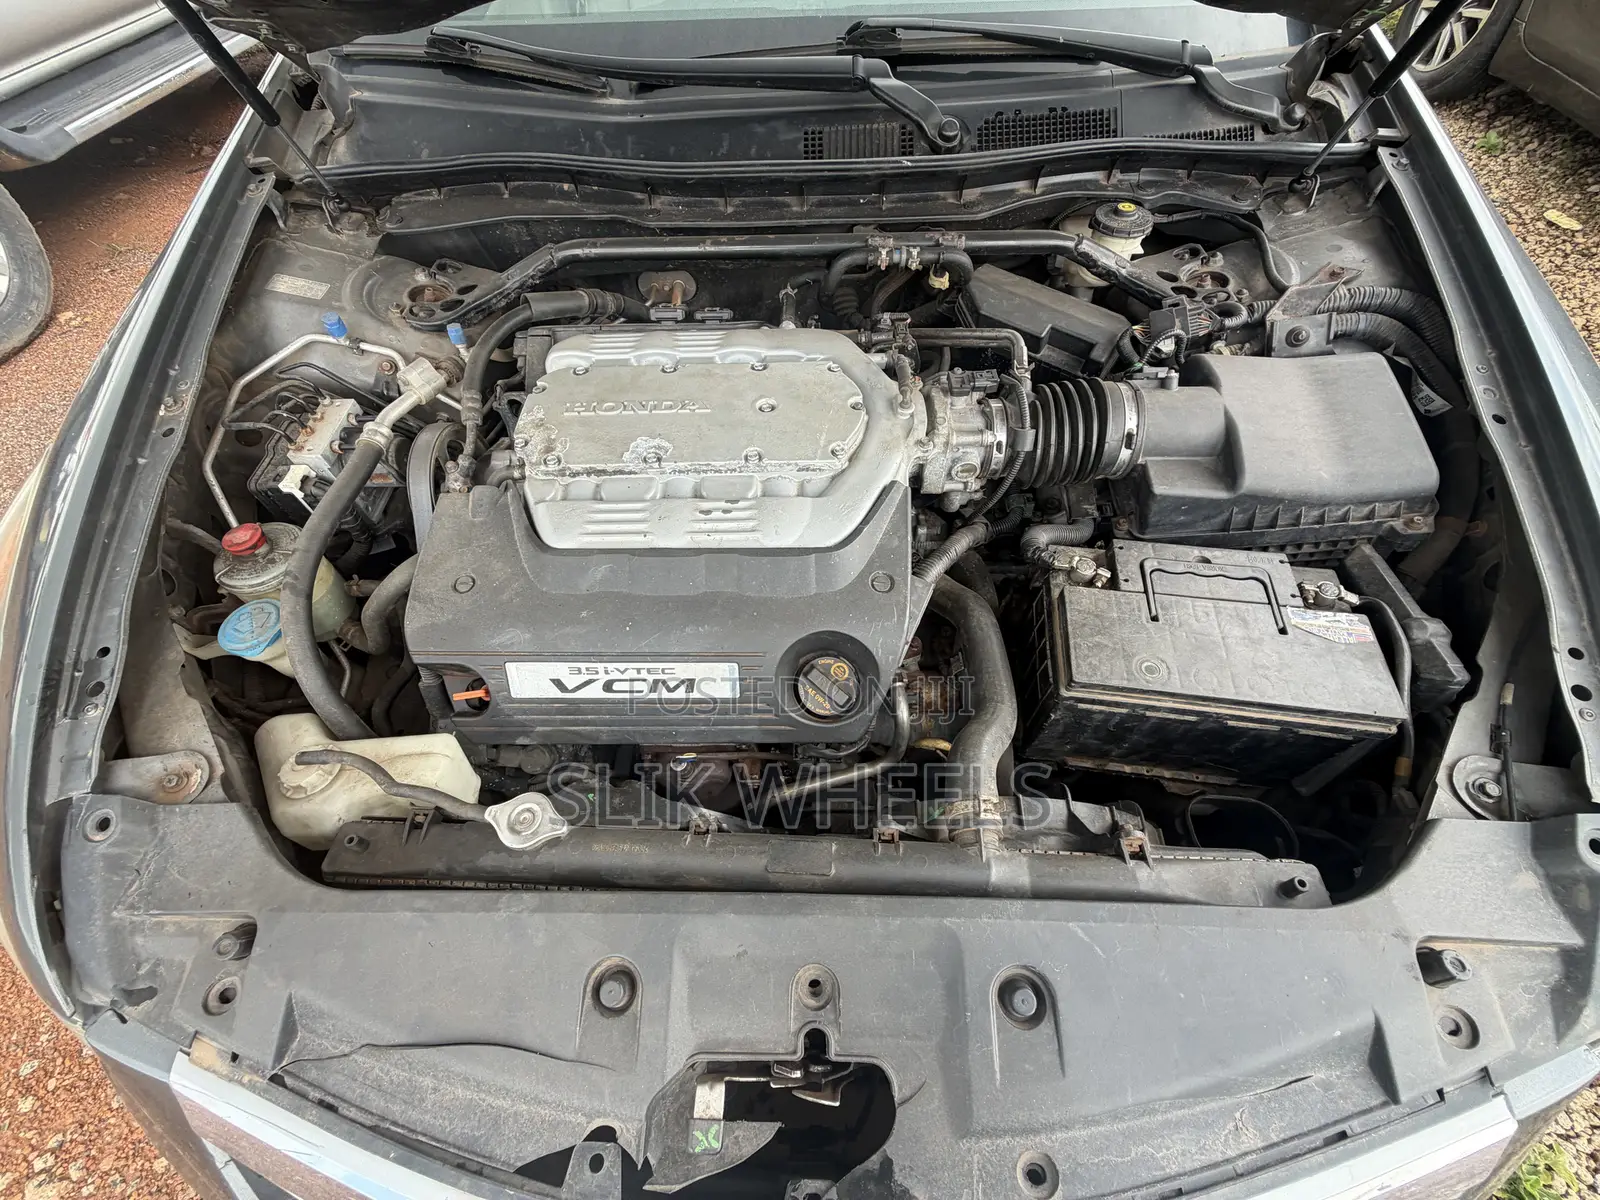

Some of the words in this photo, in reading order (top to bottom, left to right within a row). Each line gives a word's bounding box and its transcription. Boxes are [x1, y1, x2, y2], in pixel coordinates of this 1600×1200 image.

[563, 400, 711, 415] HONDA
[568, 666, 597, 675] 3.5
[603, 666, 676, 675] i-VTEC
[549, 678, 697, 694] VCM
